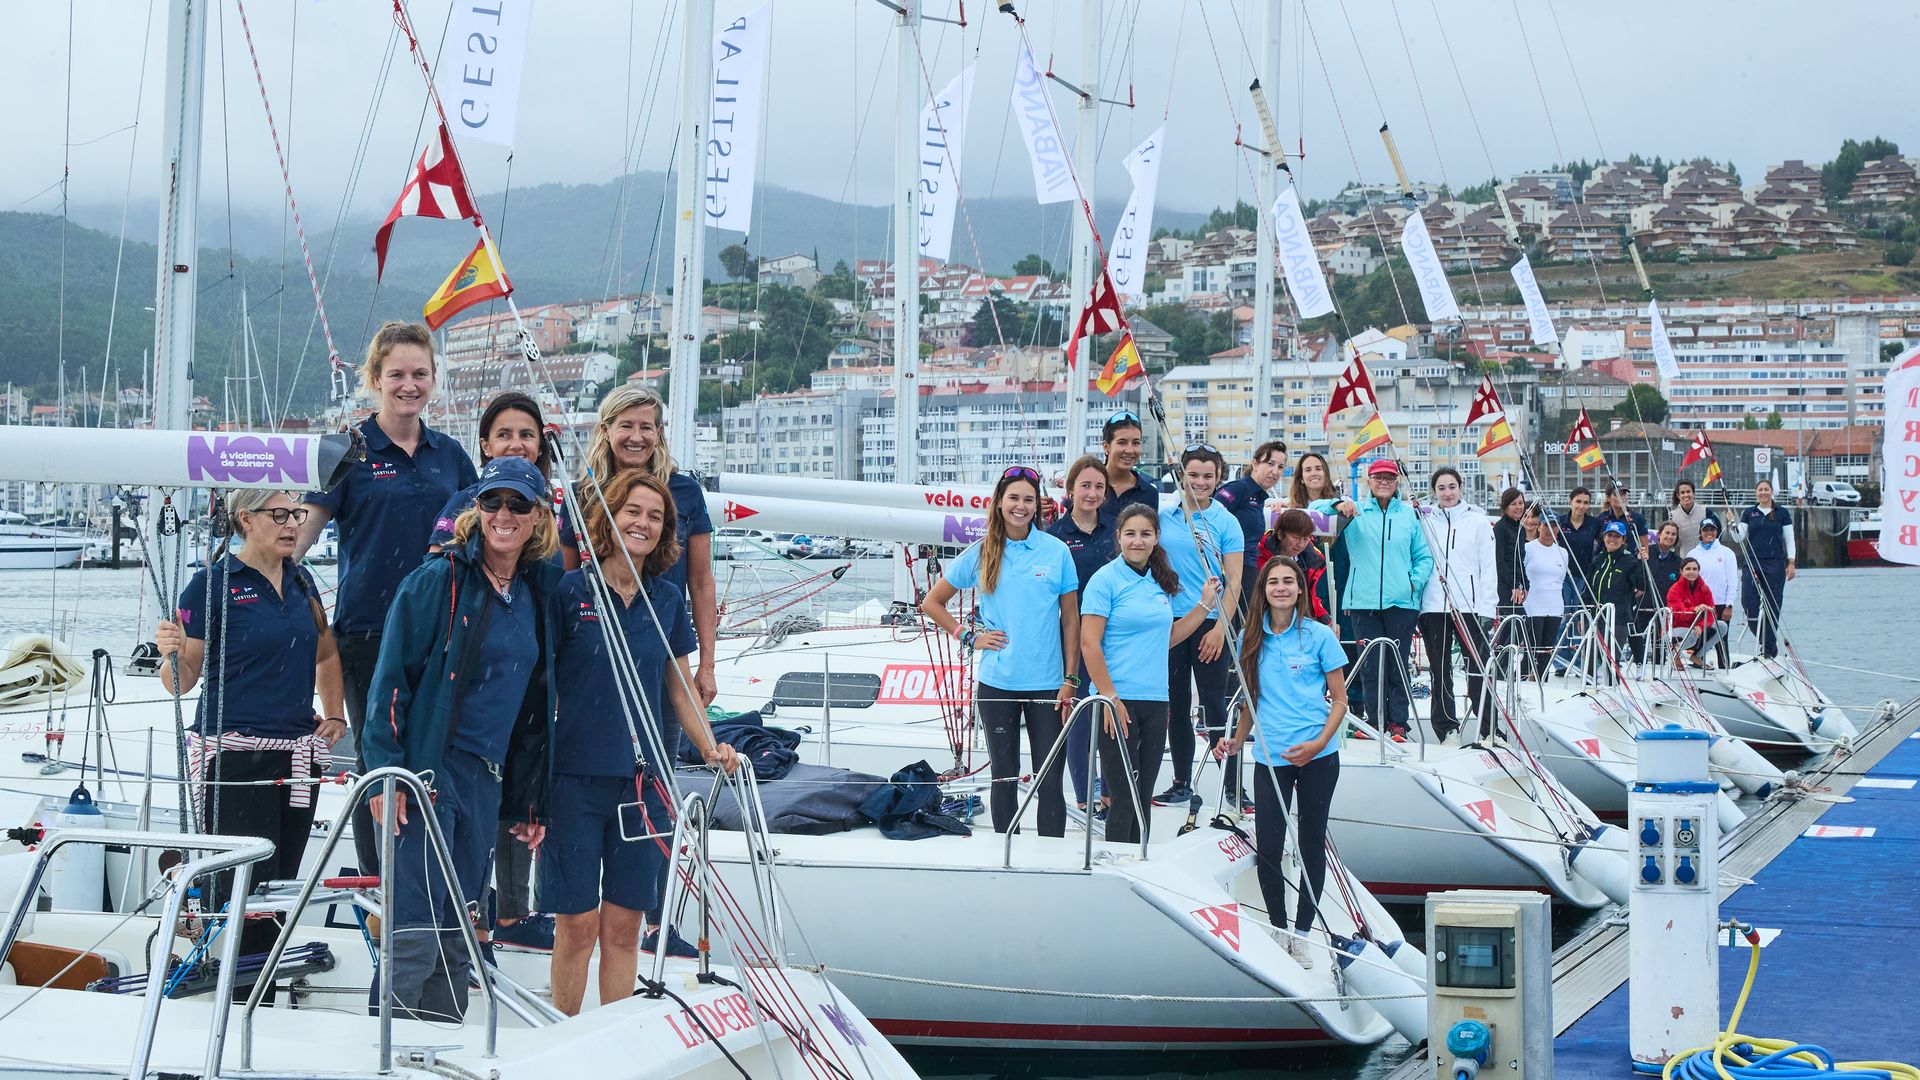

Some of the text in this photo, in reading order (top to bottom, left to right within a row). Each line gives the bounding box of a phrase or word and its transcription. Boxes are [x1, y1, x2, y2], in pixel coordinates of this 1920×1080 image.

[187, 436, 309, 484] NON
[229, 451, 275, 460] violencia
[925, 490, 964, 508] vela
[943, 515, 989, 544] NO
[881, 669, 961, 699] HOLA
